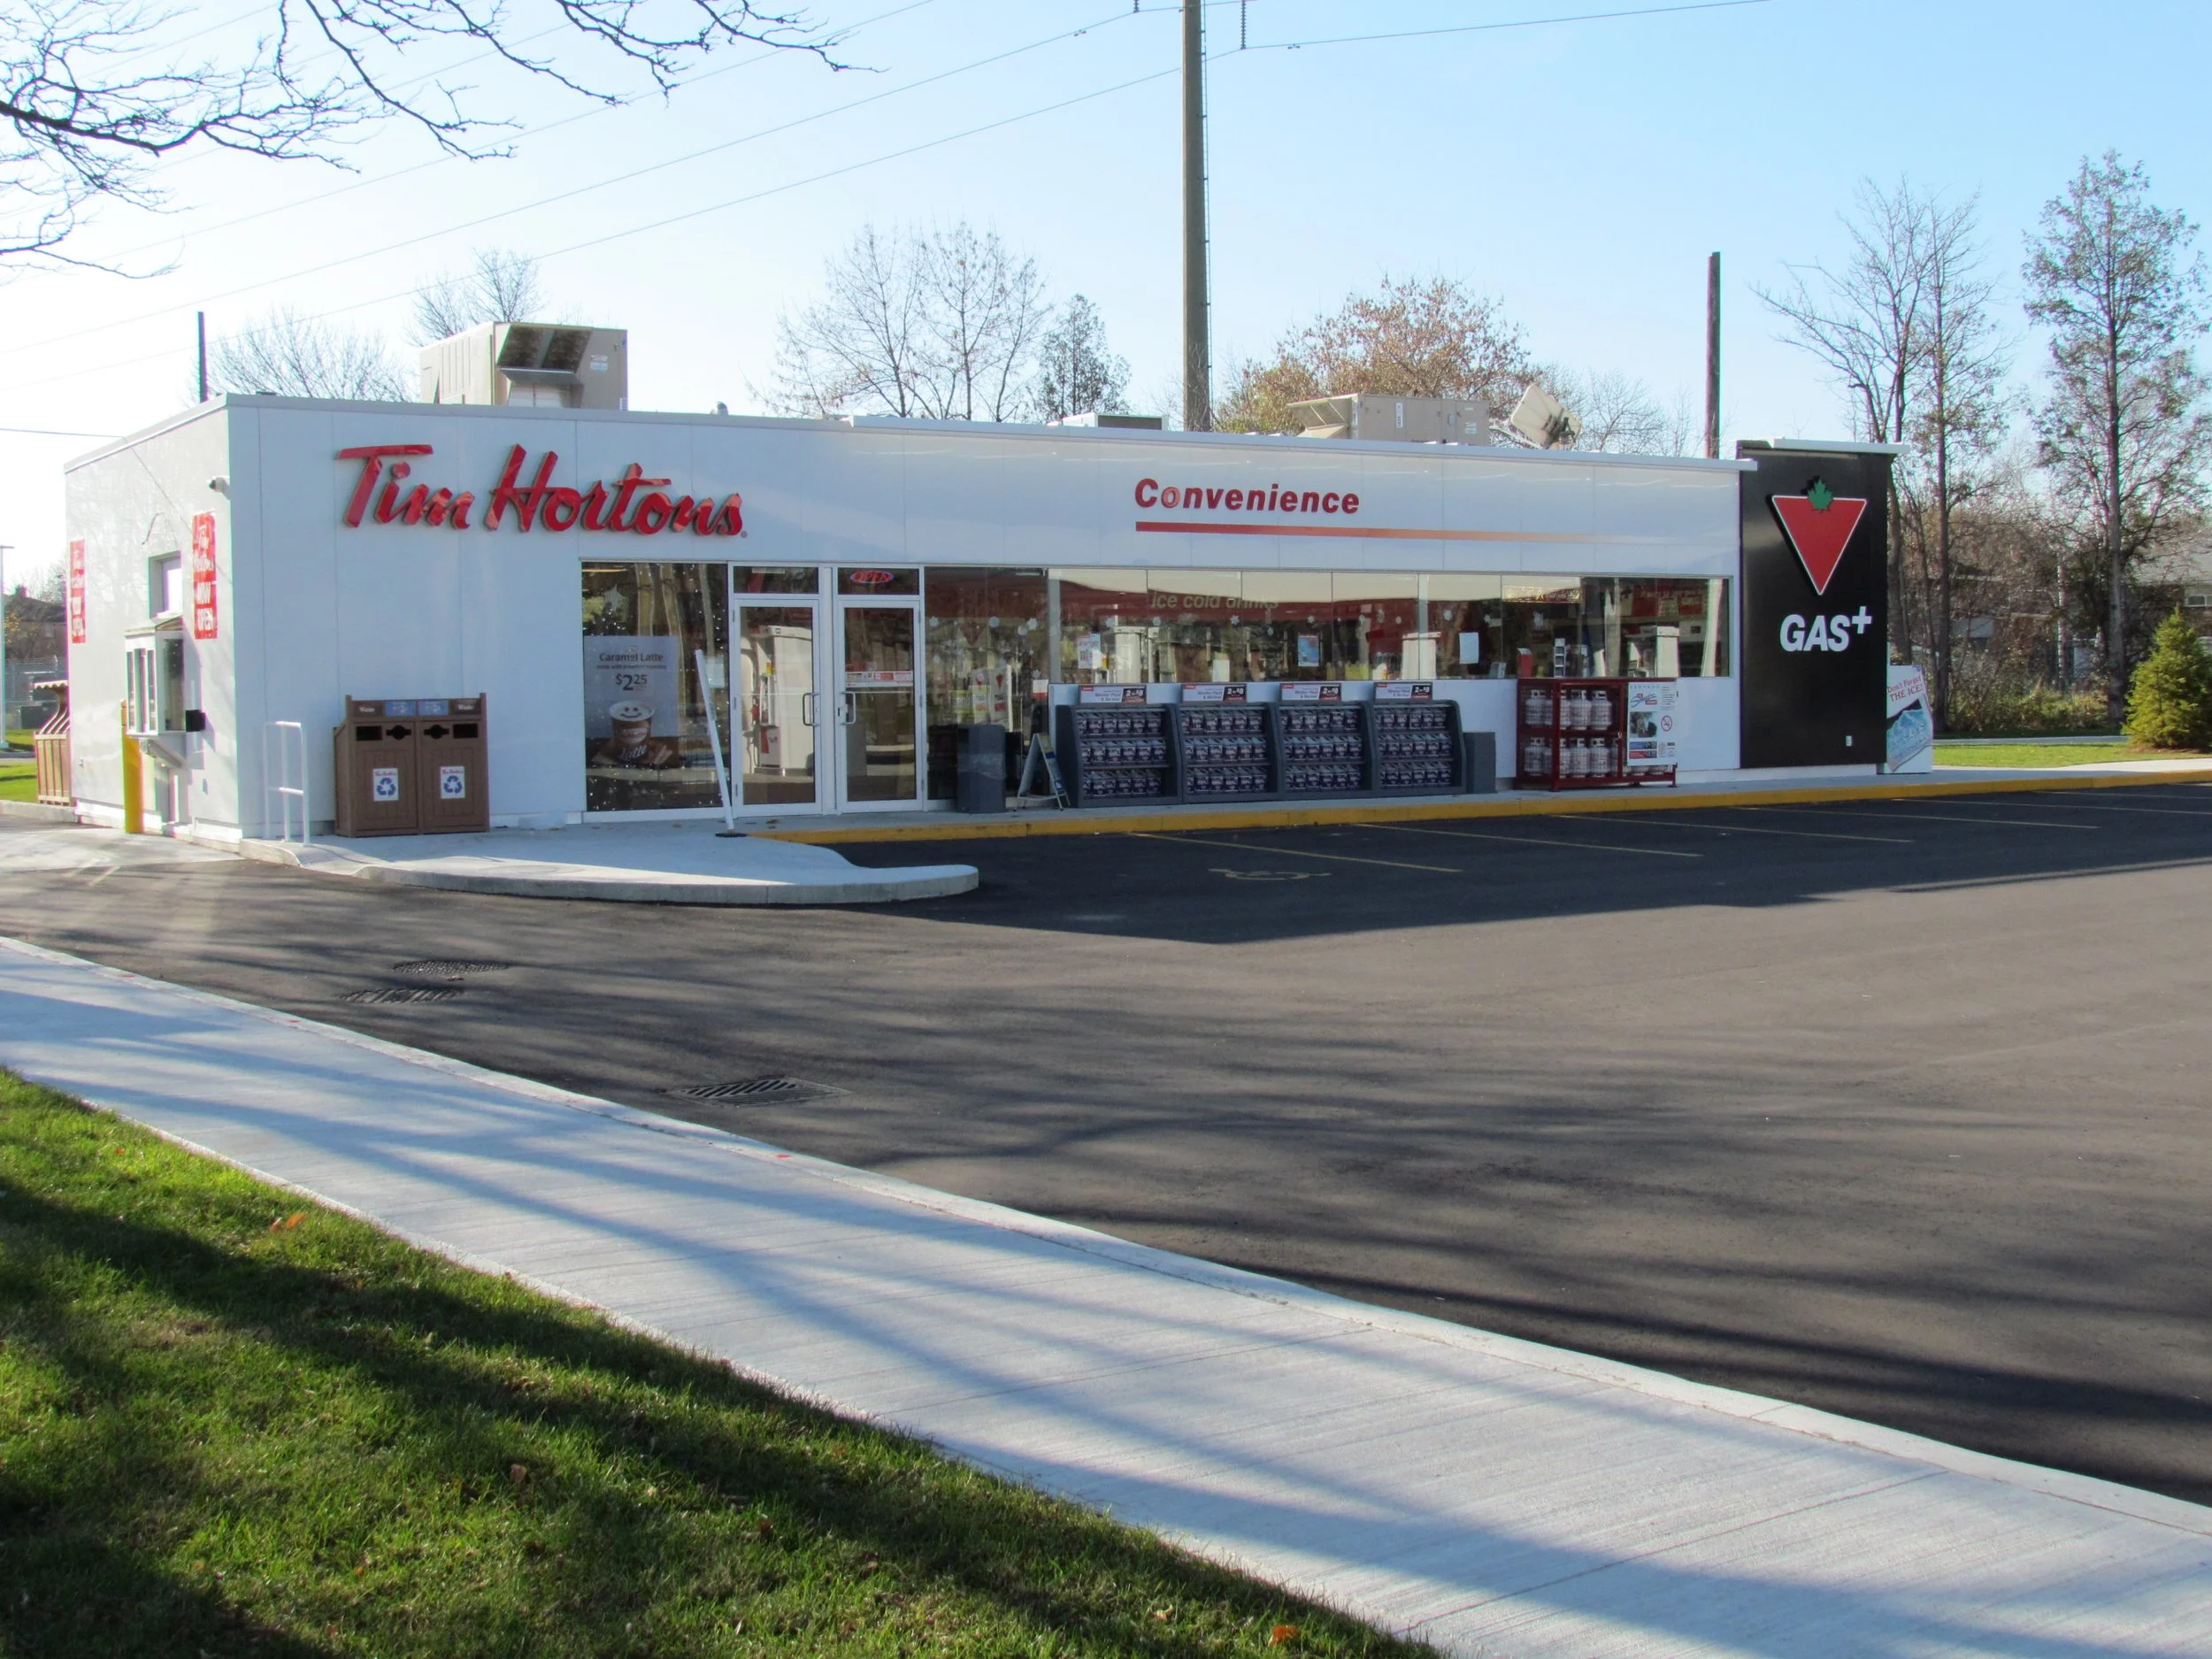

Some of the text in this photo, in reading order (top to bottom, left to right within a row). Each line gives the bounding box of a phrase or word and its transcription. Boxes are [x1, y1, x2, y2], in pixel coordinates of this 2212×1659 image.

[335, 443, 743, 536] Tim Hortons
[1135, 478, 1360, 514] Convenience
[1151, 591, 1178, 609] ice
[599, 653, 664, 662] Caramel Latte
[1890, 690, 1906, 702] THE
